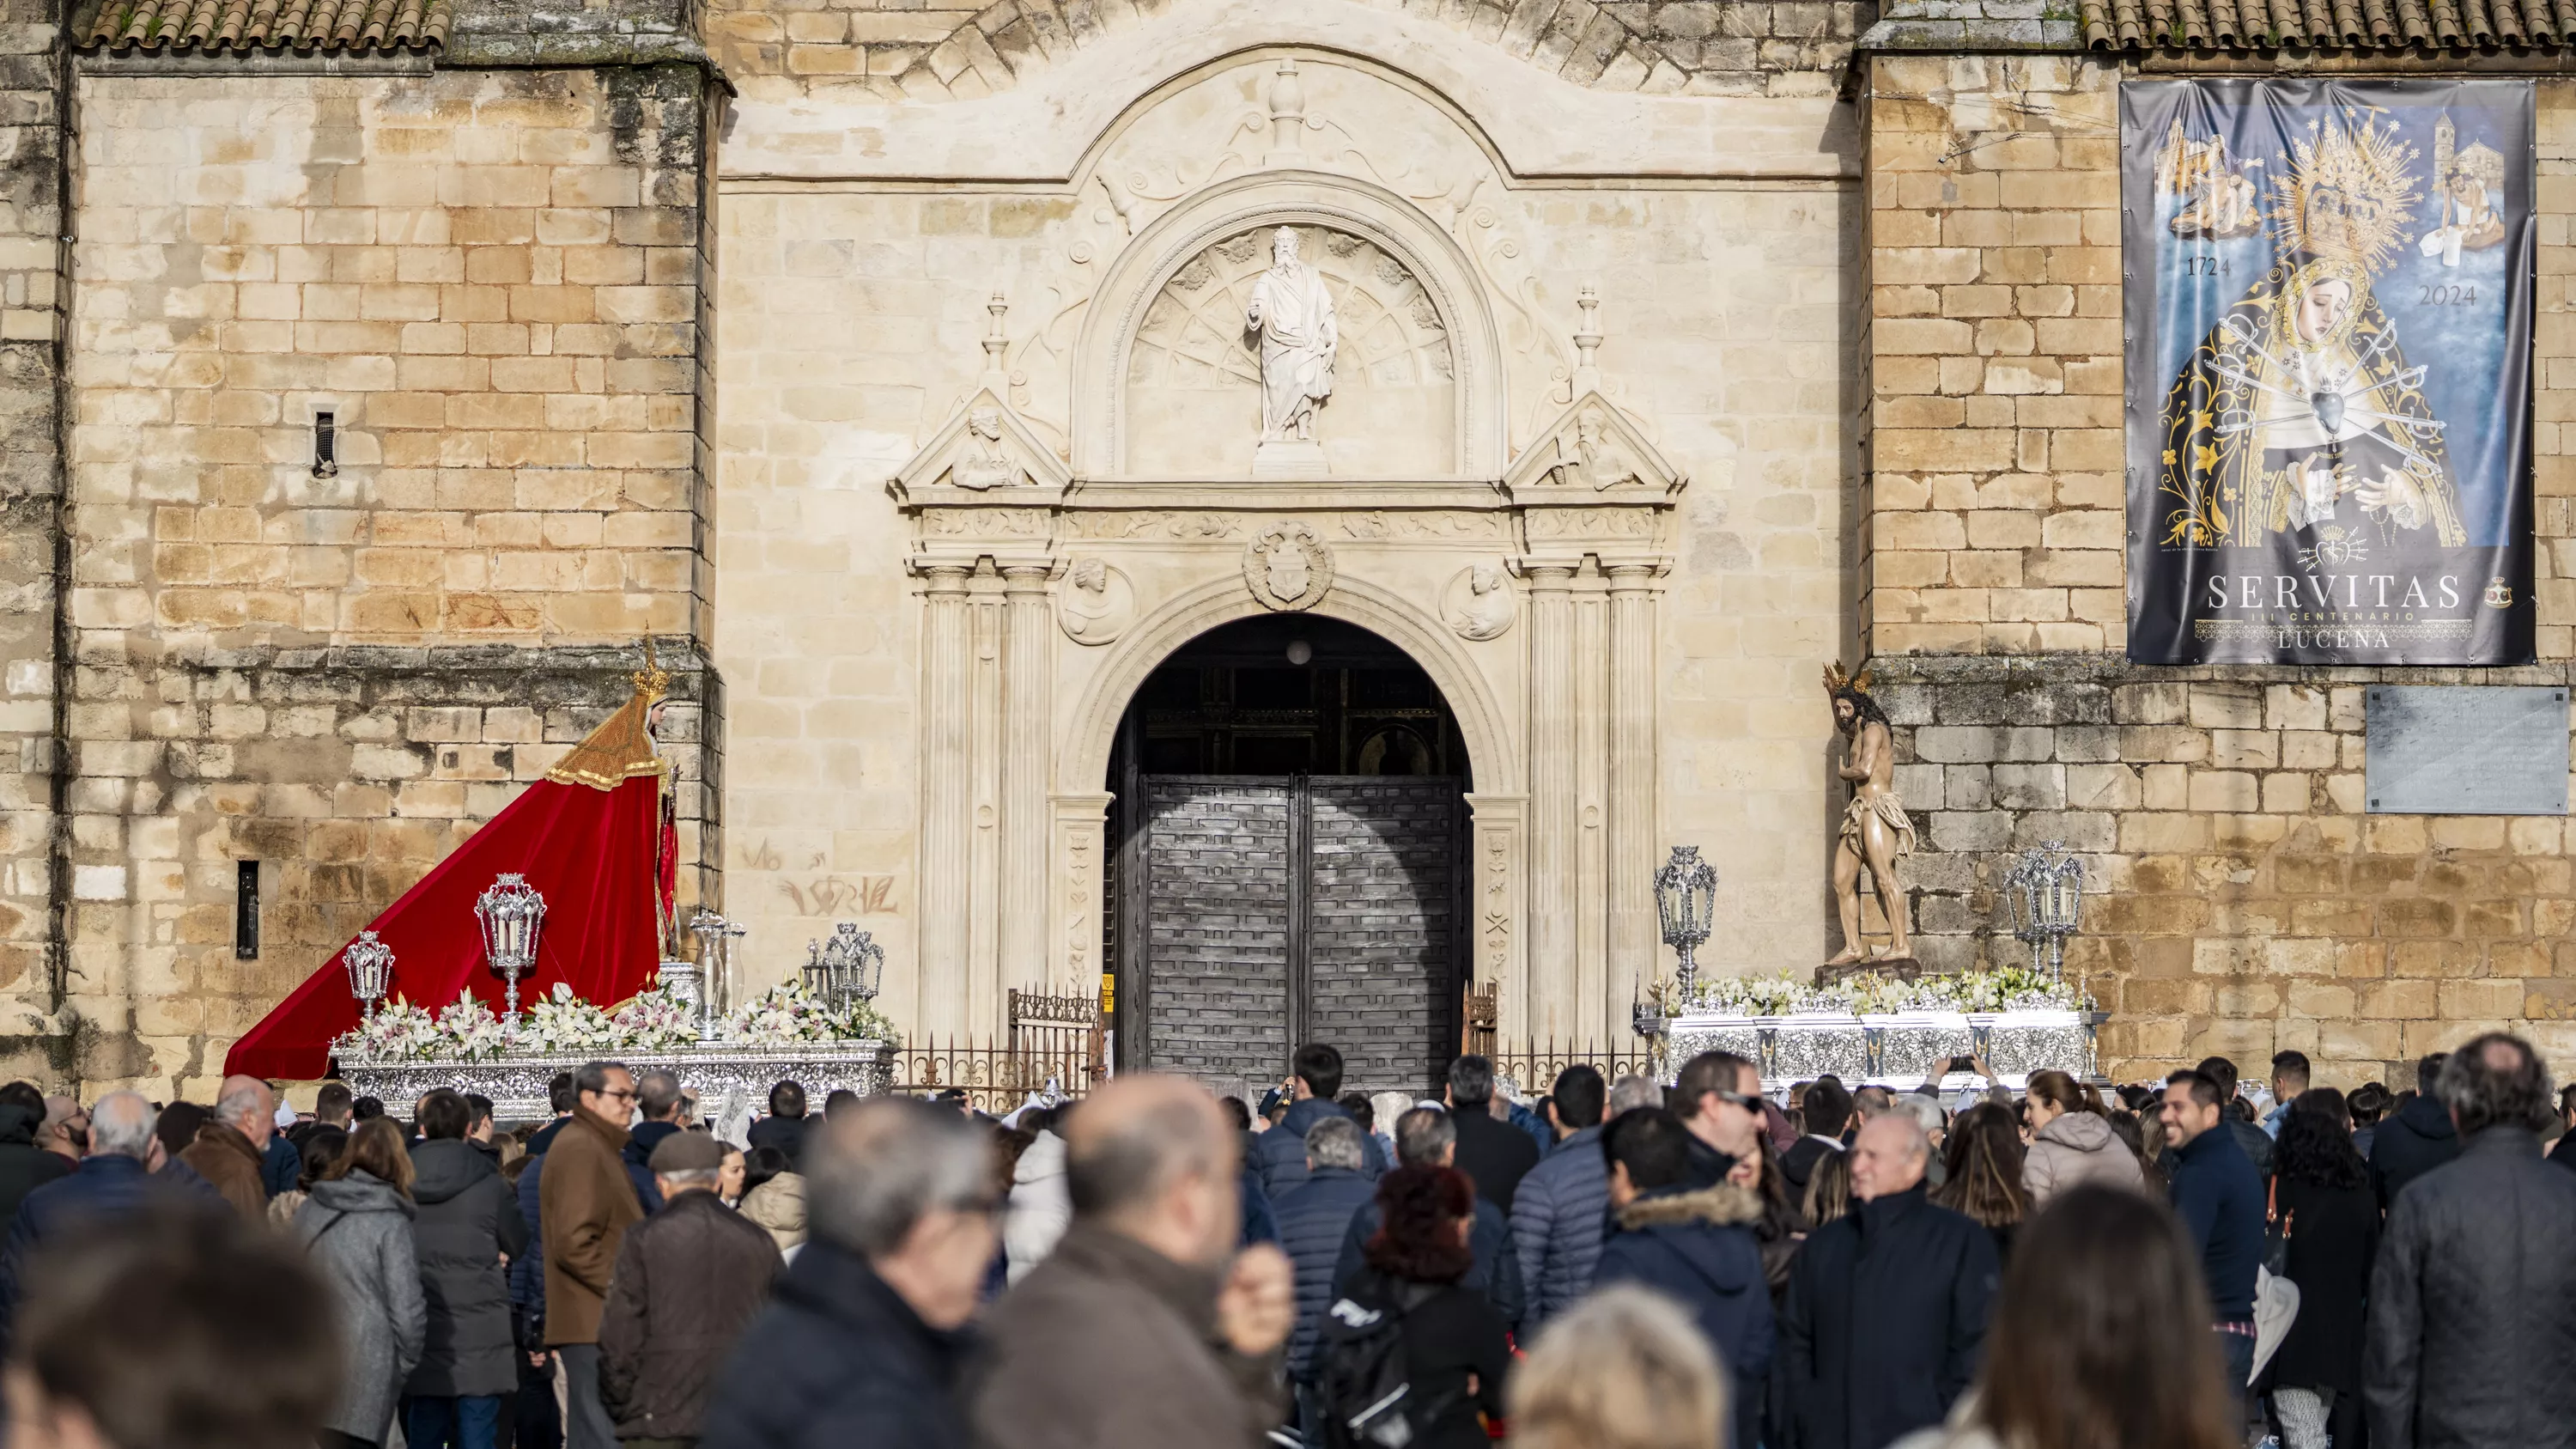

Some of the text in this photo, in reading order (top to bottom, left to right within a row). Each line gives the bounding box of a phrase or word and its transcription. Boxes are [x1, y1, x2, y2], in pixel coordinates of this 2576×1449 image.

[2187, 257, 2231, 277] 1724
[2419, 284, 2477, 307] 2024
[2208, 575, 2460, 609] SERVITAS
[2251, 612, 2415, 621] III CENTENARIO
[2278, 630, 2390, 648] LUCENA
